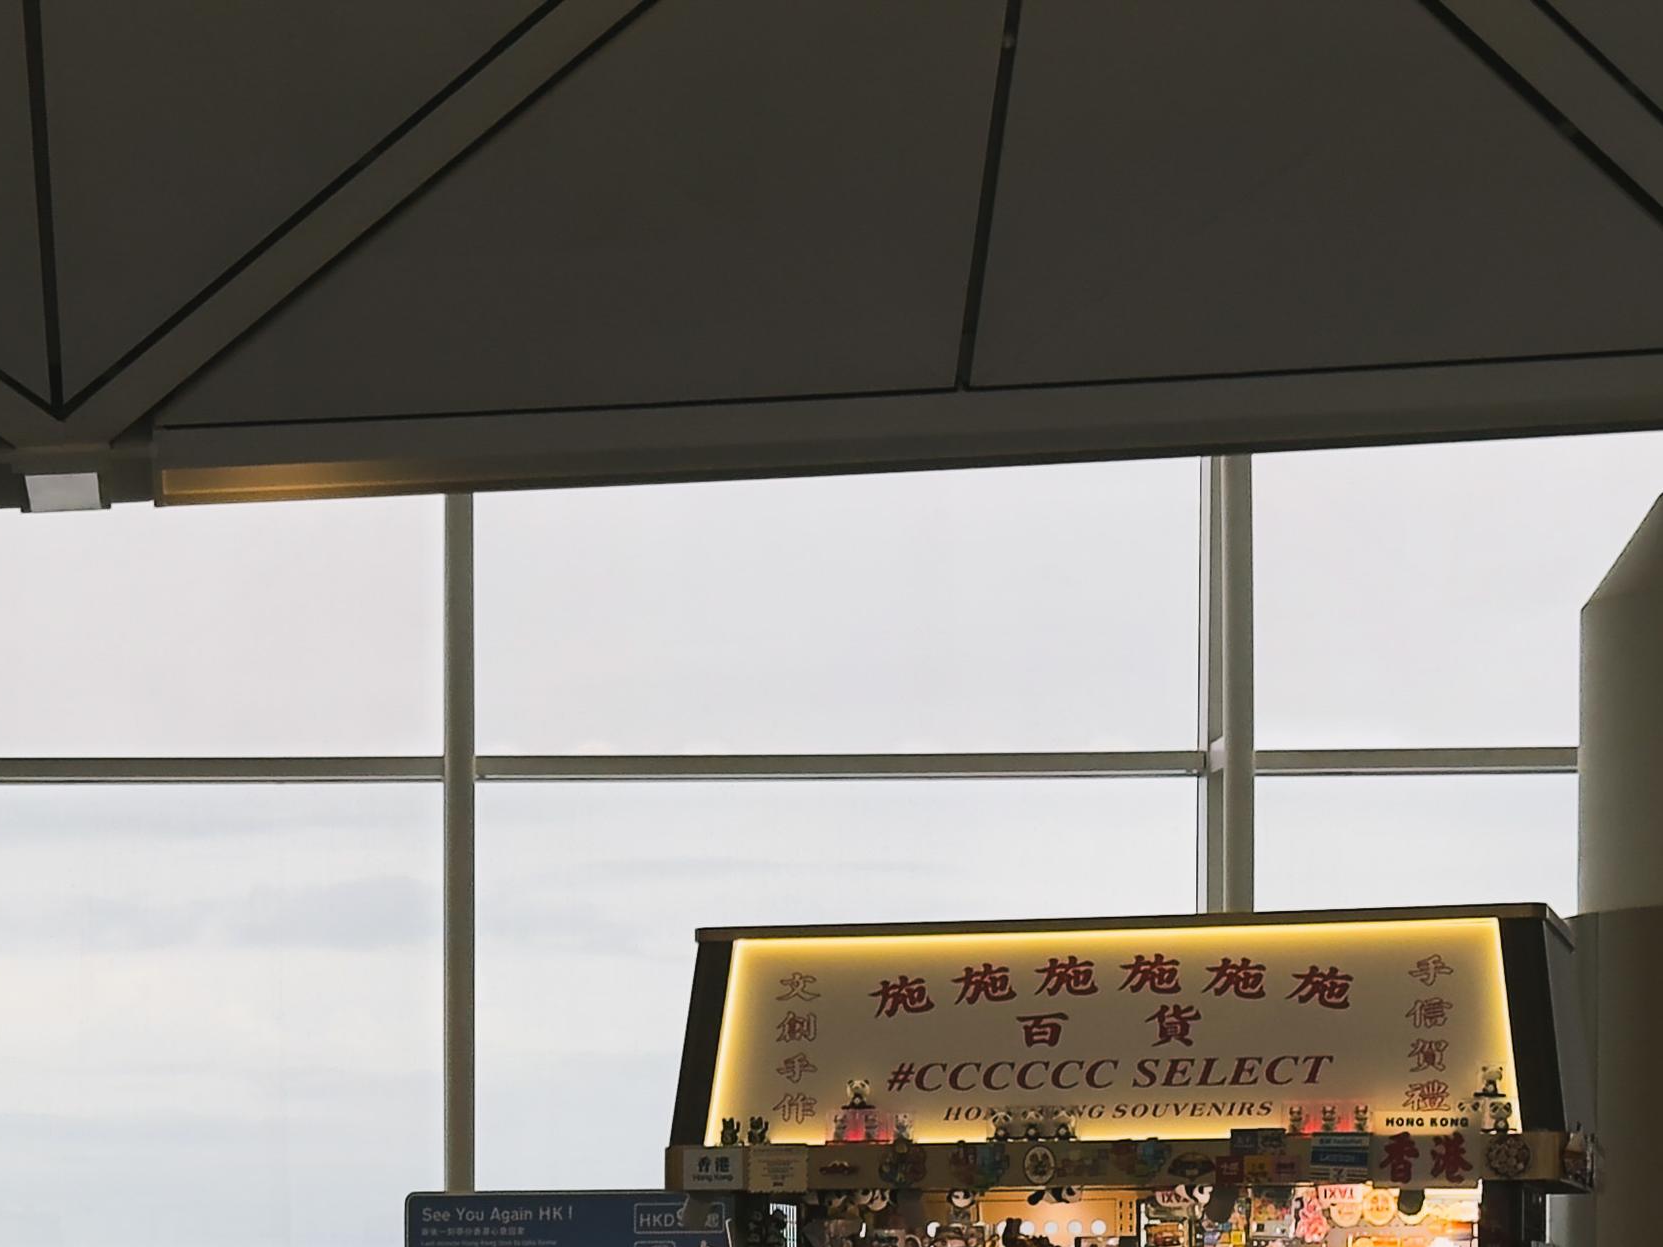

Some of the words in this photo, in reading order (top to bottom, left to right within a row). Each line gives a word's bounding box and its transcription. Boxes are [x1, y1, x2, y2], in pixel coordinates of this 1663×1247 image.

[888, 1059, 1119, 1092] #CCCCCC
[1132, 1055, 1334, 1088] SELECT
[1111, 1100, 1273, 1119] SOUVENIRS
[1386, 1116, 1424, 1127] HONG
[1430, 1116, 1469, 1127] KONG
[1380, 1132, 1473, 1184] 香港
[421, 1207, 451, 1222] See
[455, 1207, 485, 1222] You
[489, 1206, 533, 1224] Again
[538, 1205, 564, 1221] HK
